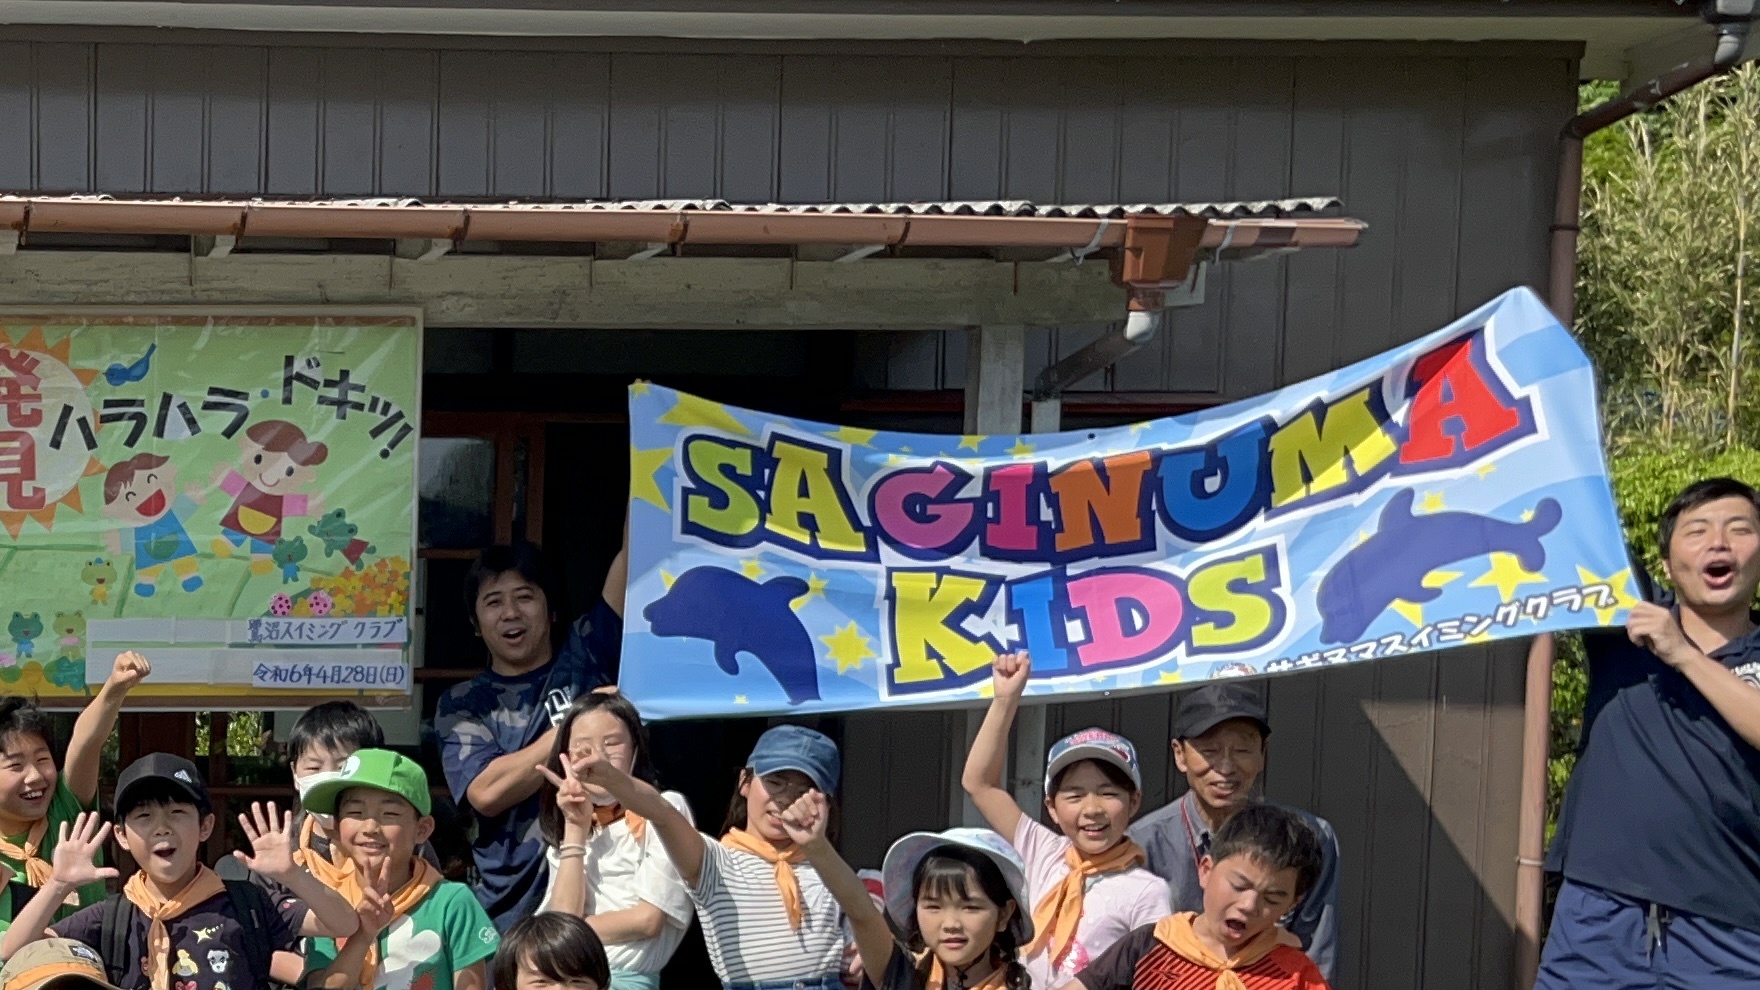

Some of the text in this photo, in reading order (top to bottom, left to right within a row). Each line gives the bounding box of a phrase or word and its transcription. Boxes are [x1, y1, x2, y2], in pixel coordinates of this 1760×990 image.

[682, 330, 1526, 556] SAGINUMA
[252, 663, 405, 685] 令和6年4月28日(日)
[884, 554, 1280, 686] KIDS
